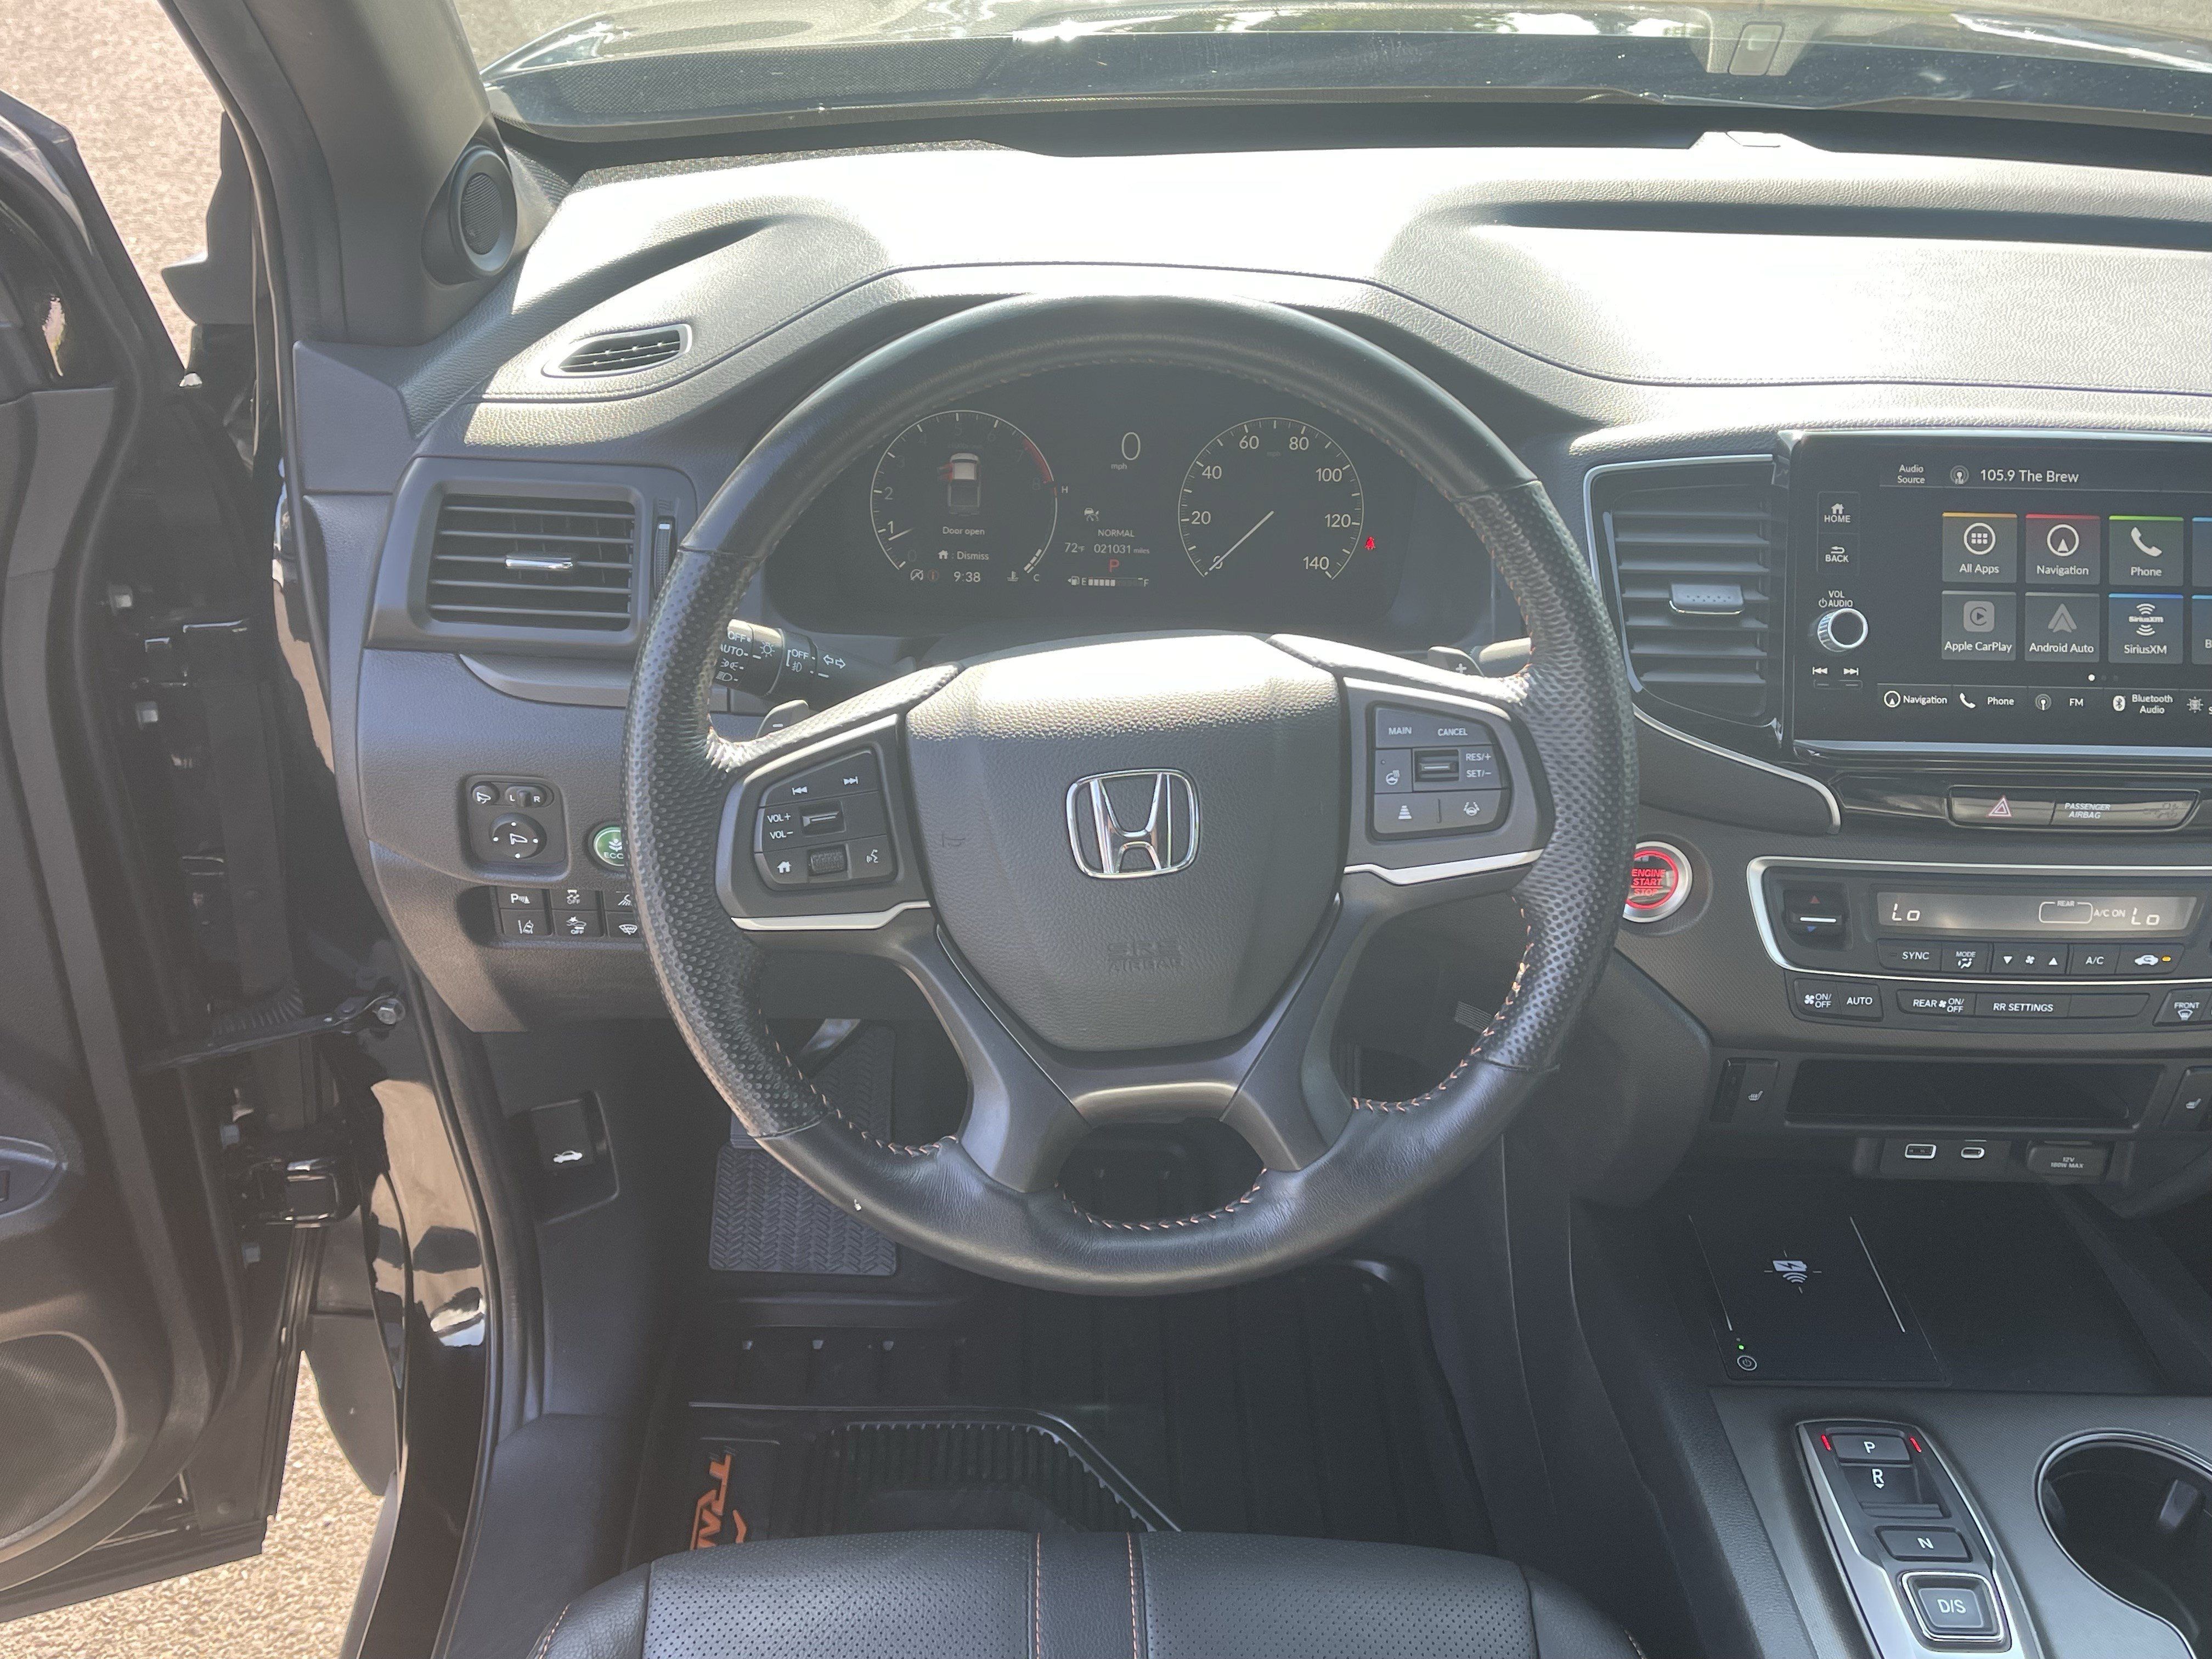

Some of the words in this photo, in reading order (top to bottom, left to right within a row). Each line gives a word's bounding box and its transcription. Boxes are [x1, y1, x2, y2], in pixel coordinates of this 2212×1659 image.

[1121, 432, 1141, 460] 0
[1239, 436, 1259, 449] 60
[1289, 436, 1309, 450] 80
[1201, 466, 1222, 480] 40
[1899, 464, 1924, 473] Audio
[1316, 468, 1342, 482] 100
[1897, 475, 1925, 484] Source
[1980, 469, 2015, 482] 105.9
[2018, 470, 2044, 482] The
[2046, 470, 2079, 483] Brew
[884, 487, 894, 500] 2
[1191, 511, 1211, 525] 20
[1324, 514, 1351, 528] 120
[1824, 514, 1851, 523] HOME
[887, 522, 894, 534] 1
[965, 528, 985, 537] open
[1098, 529, 1135, 538] NORMAL
[1093, 544, 1131, 554] 021031
[957, 551, 989, 561] Dismiss
[1825, 554, 1849, 563] BACK
[1109, 558, 1120, 573] P
[1303, 556, 1329, 571] 140
[1959, 563, 1972, 573] All
[1974, 564, 1999, 575] Apps
[2036, 565, 2089, 577] Navigation
[2131, 567, 2162, 577] Phone
[953, 571, 981, 583] 9:38
[1034, 574, 1040, 582] C
[1081, 578, 1087, 586] E
[1143, 578, 1149, 587] F
[1828, 590, 1844, 599] VOL
[1828, 599, 1853, 608] AUDIO
[727, 630, 746, 643] OFF
[1944, 640, 1973, 652] Apple
[1976, 641, 2012, 654] CarPlay
[2029, 642, 2068, 653] Android
[2070, 644, 2095, 653] Auto
[2124, 644, 2167, 655] SiriusXM
[791, 648, 809, 659] OFF
[1903, 695, 1948, 706] Navigation
[1987, 696, 2015, 706] Phone
[2069, 697, 2084, 707] FM
[2132, 694, 2173, 703] Bluetooth
[2140, 705, 2165, 714] Audio
[1388, 726, 1412, 735] MAIN
[1437, 728, 1468, 736] CANCEL
[1465, 753, 1492, 761] RES/+
[2064, 802, 2111, 812] PASSENGER
[2068, 811, 2101, 819] AIRBAG
[1631, 868, 1666, 877] ENGINE
[1633, 878, 1662, 886] START
[2094, 909, 2109, 918] A/C
[2112, 909, 2126, 918] ON
[1902, 951, 1930, 960] SYNC
[2086, 956, 2104, 965] A/C
[1815, 993, 1832, 1002] ON/
[1847, 996, 1873, 1005] AUTO
[1948, 997, 1965, 1006] ON/
[1815, 1000, 1832, 1009] OFF
[1913, 999, 1937, 1008] REAR
[1993, 1003, 2006, 1011] RR
[2008, 1003, 2054, 1012] SETTINGS
[1946, 1005, 1963, 1013] OFF
[1864, 1441, 1875, 1453] P
[1872, 1468, 1884, 1484] R
[1917, 1537, 1934, 1550] N
[1937, 1599, 1966, 1614] D/S
